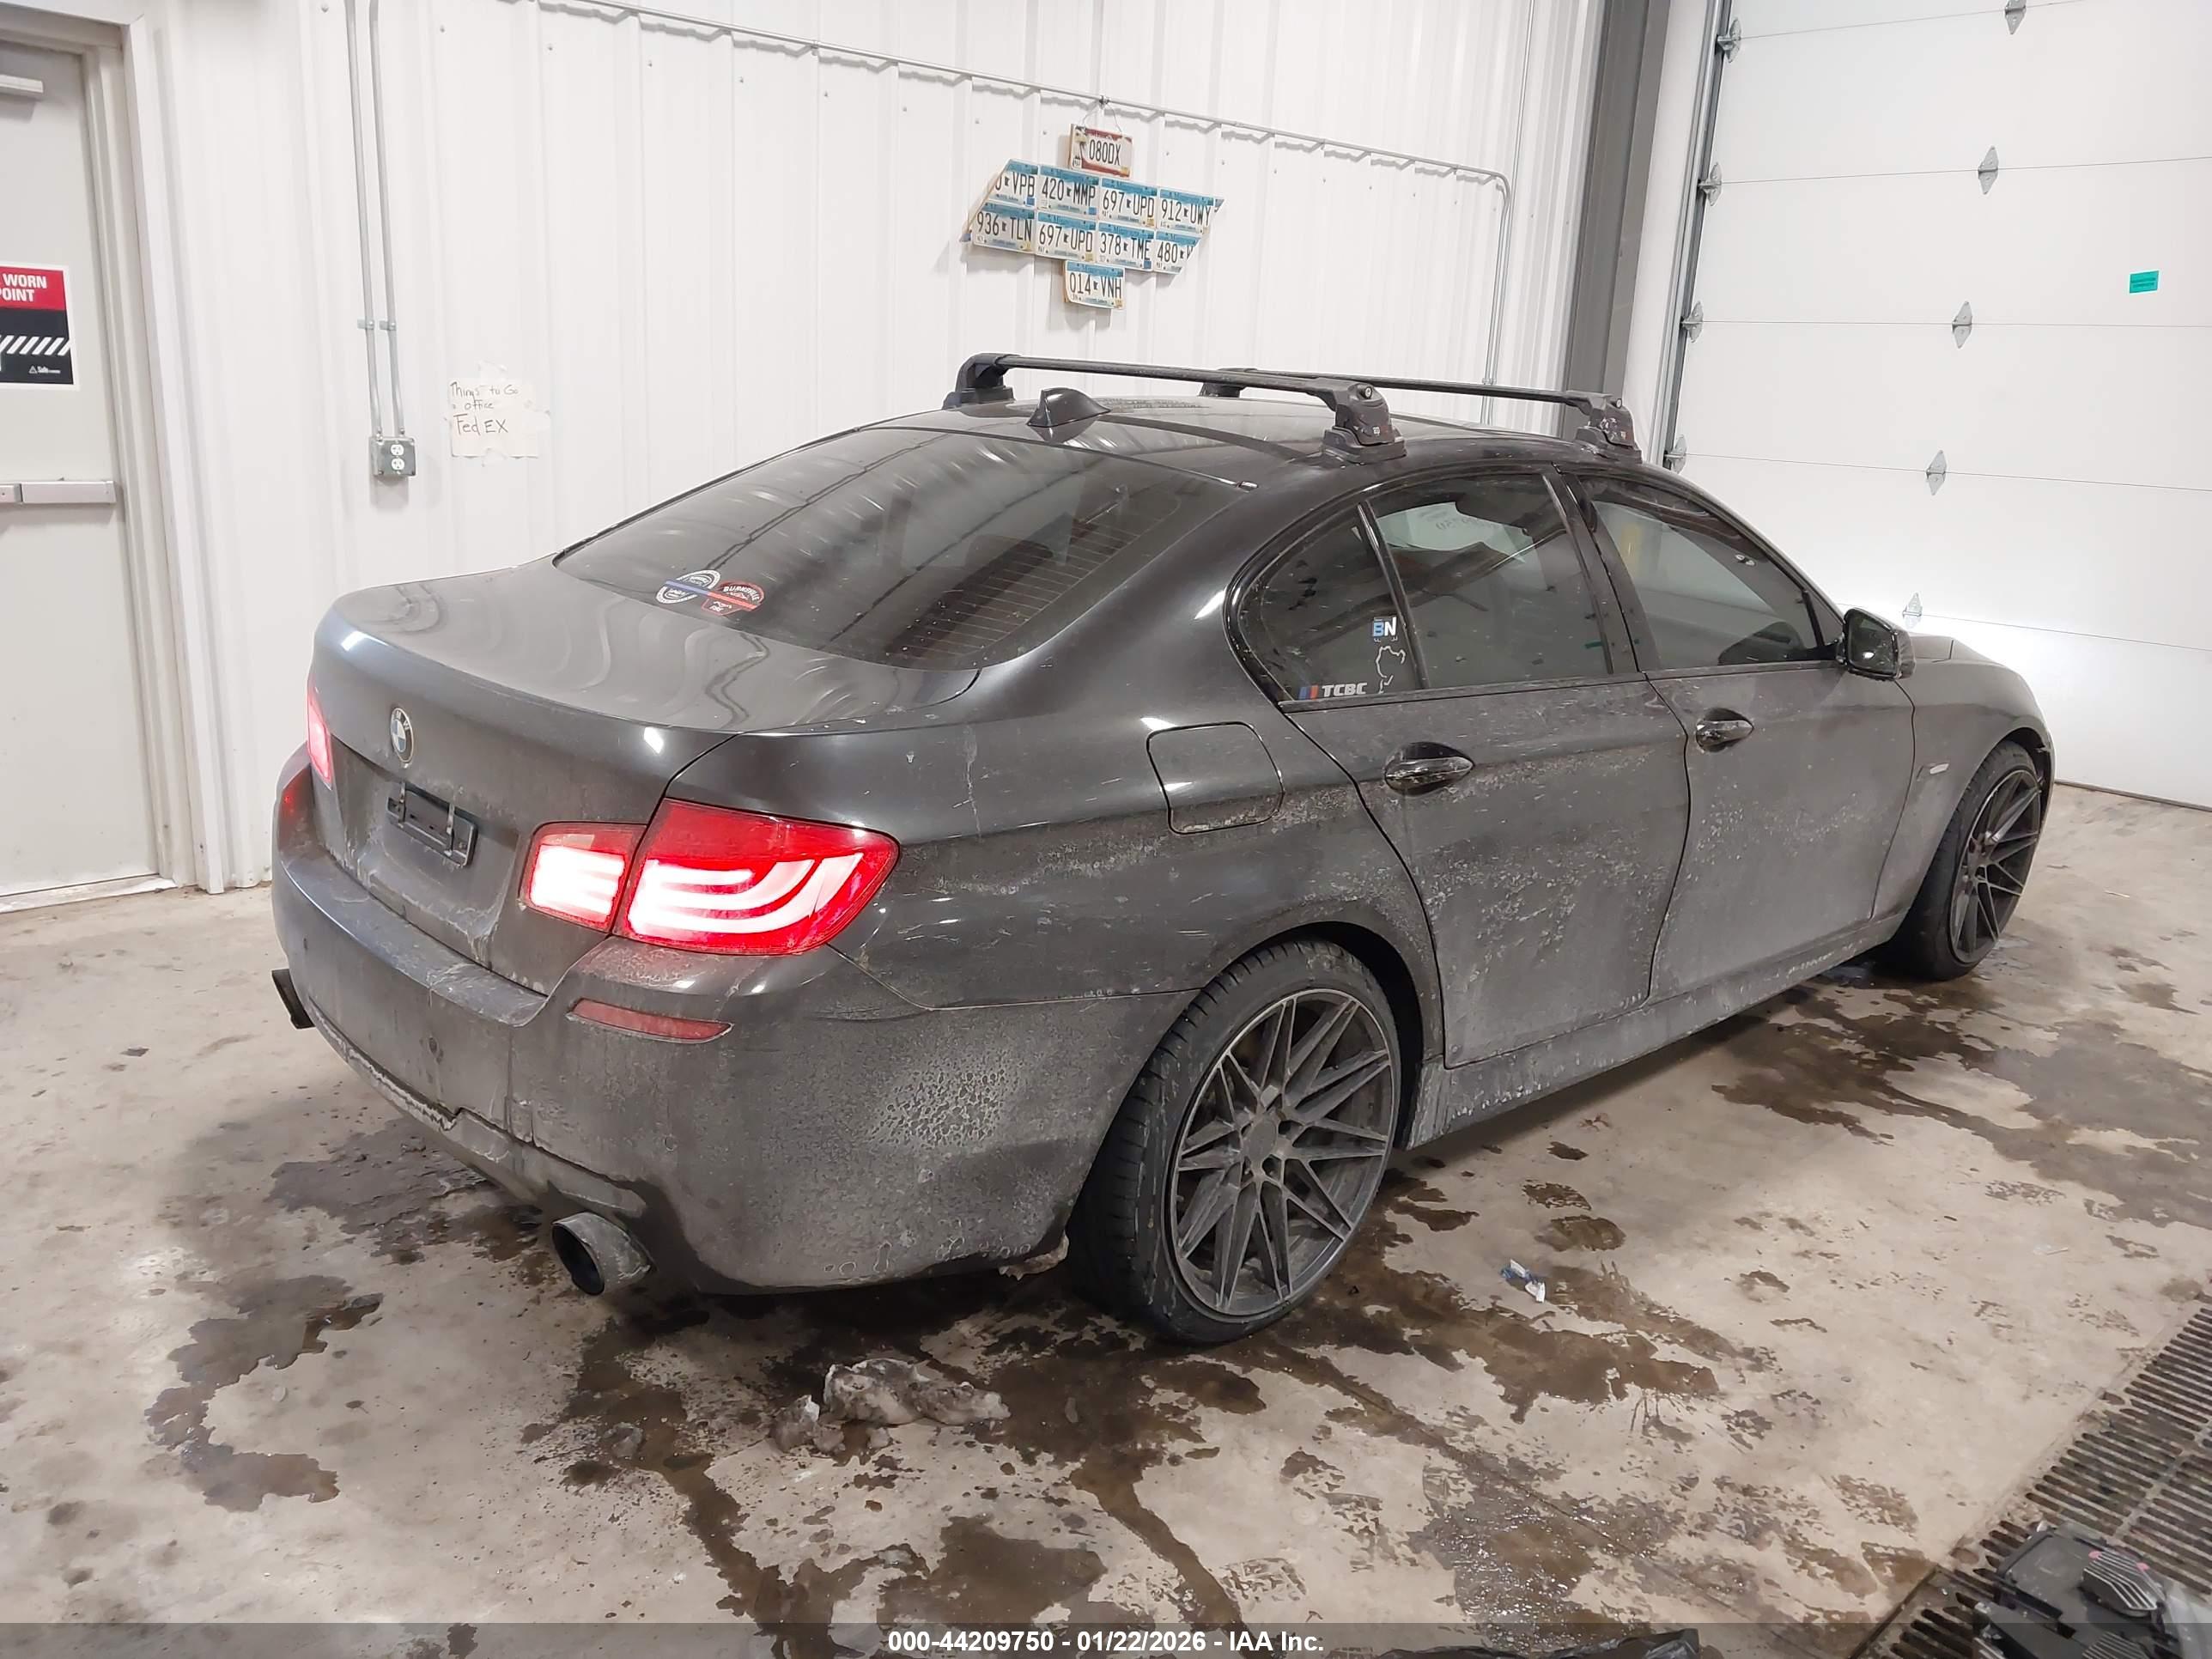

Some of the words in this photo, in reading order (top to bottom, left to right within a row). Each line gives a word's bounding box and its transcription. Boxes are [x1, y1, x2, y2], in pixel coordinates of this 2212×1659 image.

[1042, 177, 1064, 201] 420
[1073, 182, 1096, 206] MMP
[1103, 190, 1125, 213] 697
[1133, 195, 1155, 218] UPD
[976, 211, 1000, 236] 936
[1010, 216, 1032, 242] TLN
[1161, 199, 1182, 222] 912
[1190, 204, 1211, 227] UWY
[1039, 224, 1062, 247] 697
[1070, 228, 1093, 252] UPD
[1100, 232, 1121, 256] 378
[1131, 237, 1152, 261] TME
[1157, 241, 1178, 264] 480
[3, 272, 48, 289] WORN
[1069, 272, 1091, 295] 014
[1100, 276, 1122, 300] VNH
[1322, 682, 1368, 698] TCBC
